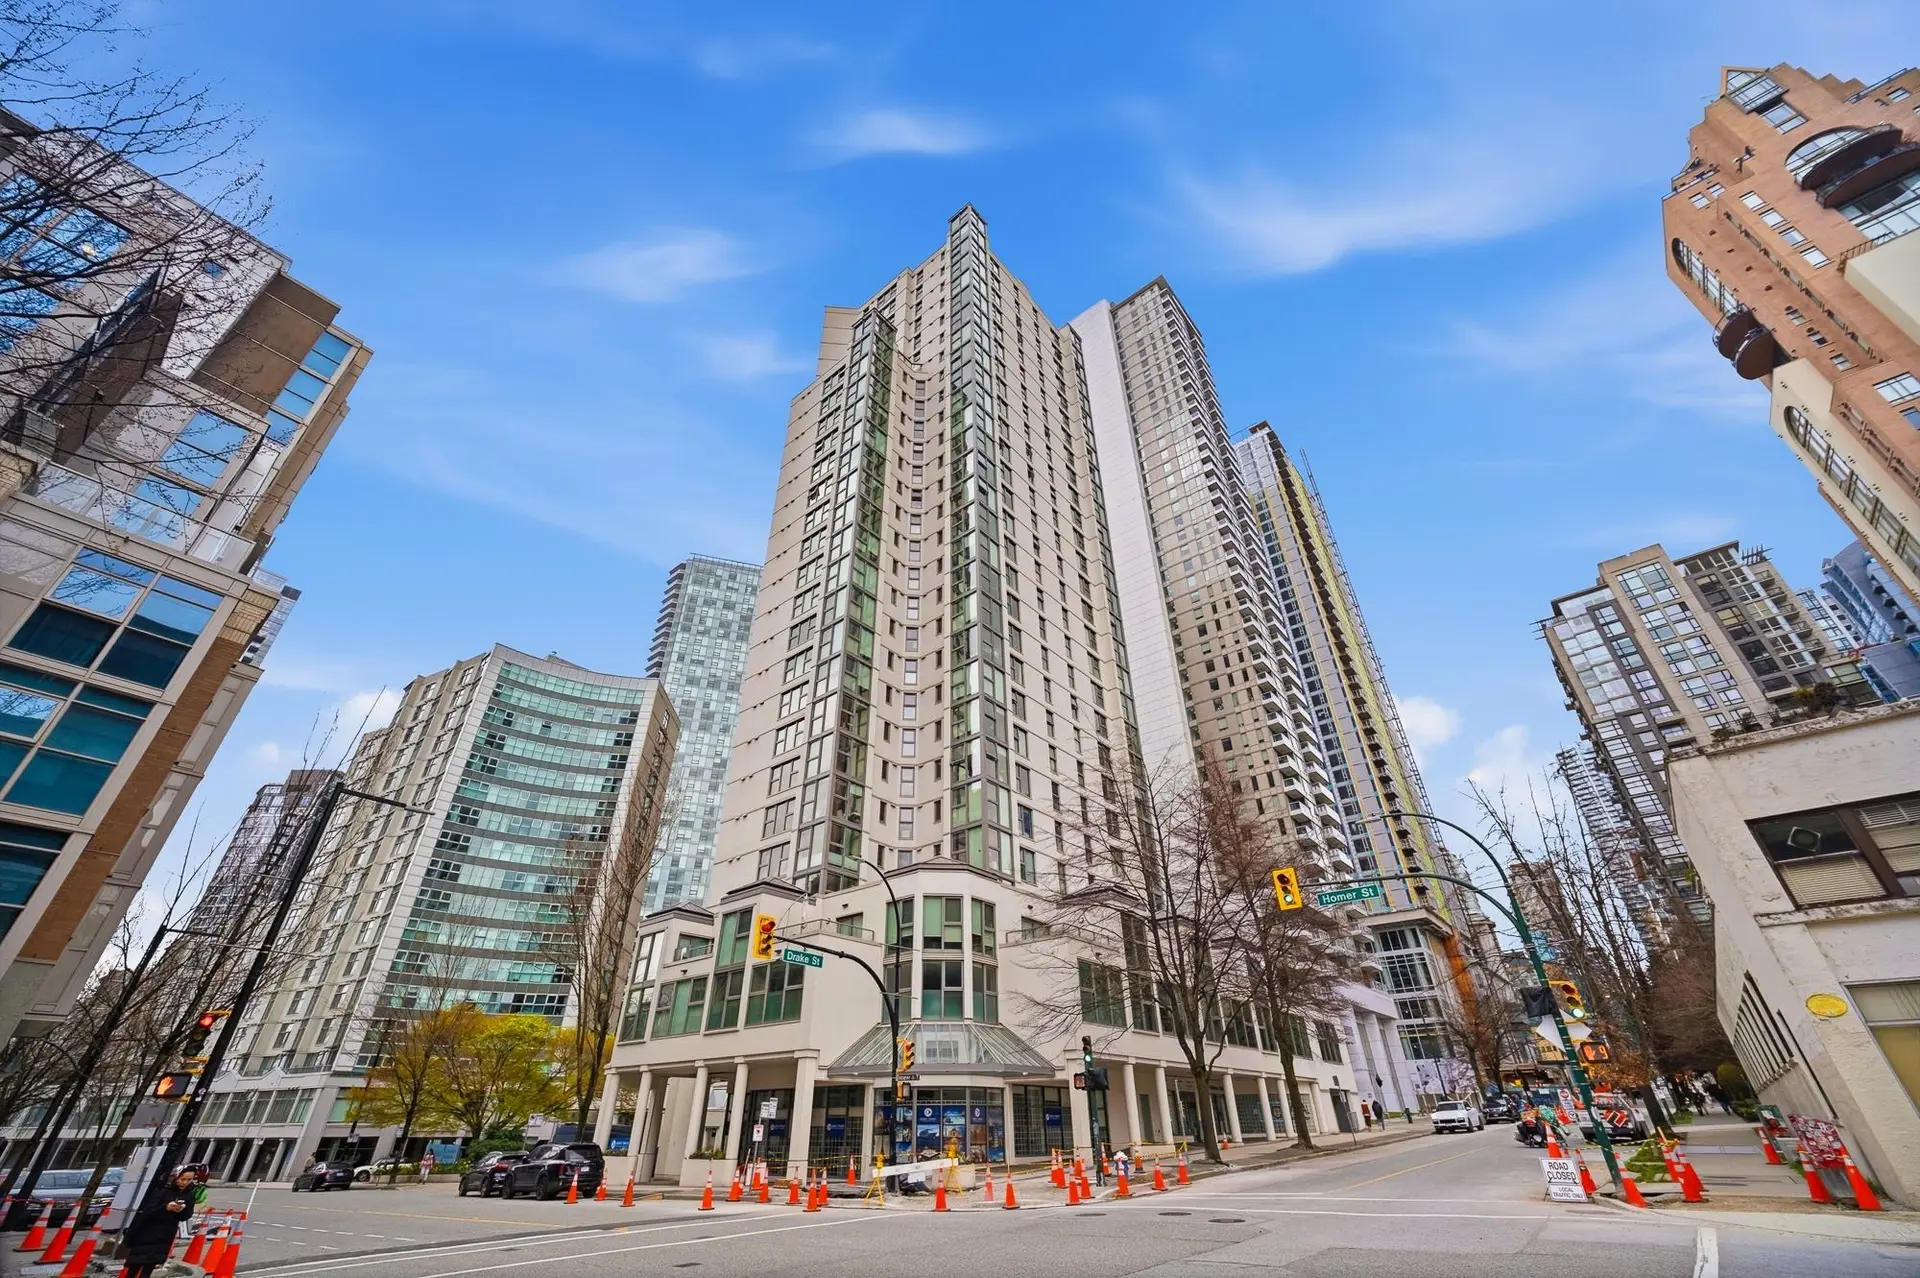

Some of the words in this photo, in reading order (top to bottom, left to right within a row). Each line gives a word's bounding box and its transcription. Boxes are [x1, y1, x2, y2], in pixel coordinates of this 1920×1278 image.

[1322, 892, 1357, 904] Homer
[1361, 887, 1374, 897] St
[786, 951, 810, 964] Drake
[811, 956, 820, 966] St
[1548, 1161, 1569, 1171] ROAD
[1546, 1171, 1577, 1180] CLOSED
